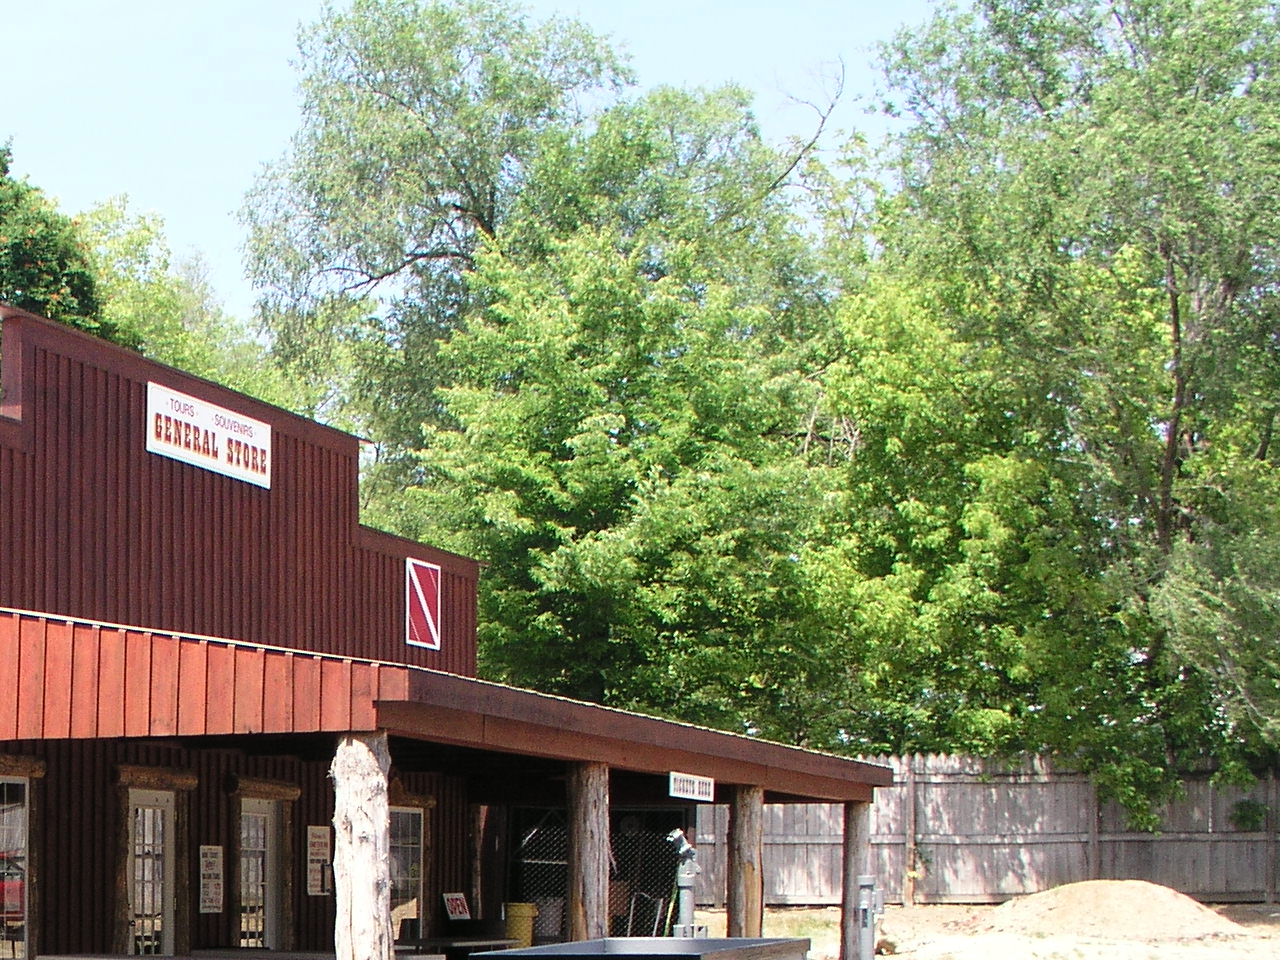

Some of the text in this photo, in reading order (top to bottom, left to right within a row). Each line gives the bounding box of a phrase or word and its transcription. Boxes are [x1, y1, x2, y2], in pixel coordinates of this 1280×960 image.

[170, 398, 195, 418] TOURS
[214, 414, 254, 438] SOUVENIRS
[154, 412, 267, 475] GENERAL STORE
